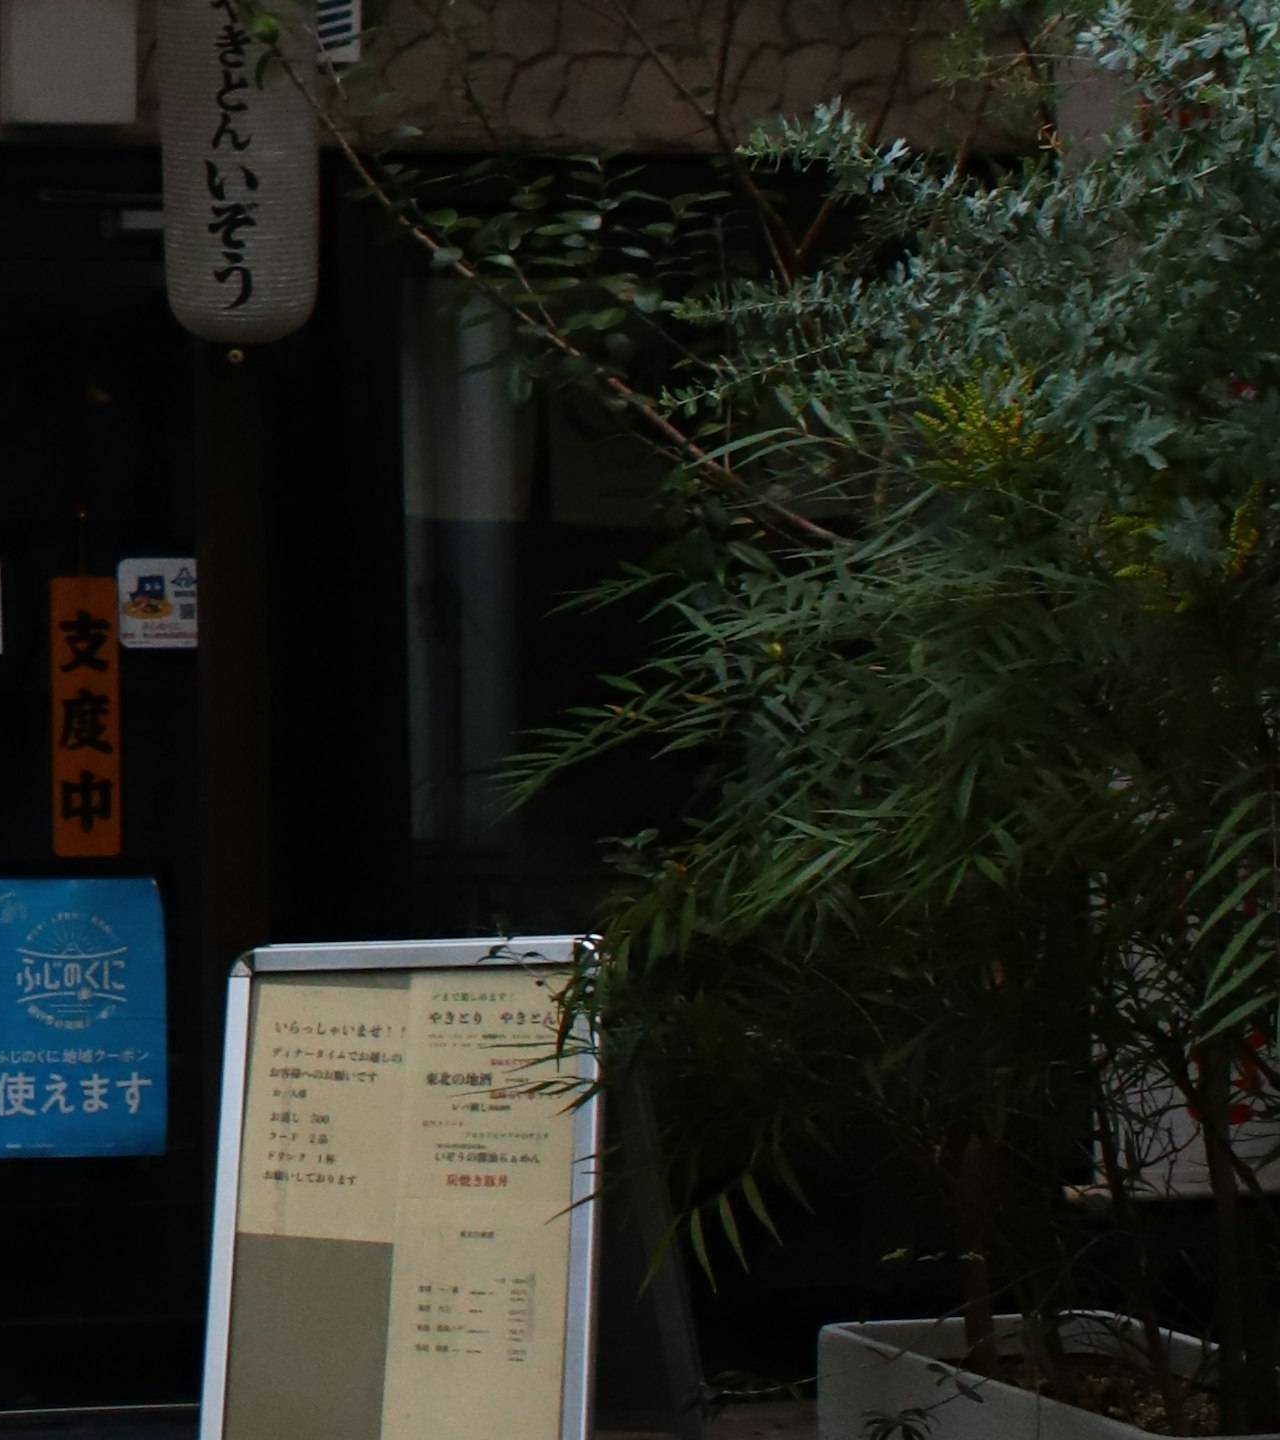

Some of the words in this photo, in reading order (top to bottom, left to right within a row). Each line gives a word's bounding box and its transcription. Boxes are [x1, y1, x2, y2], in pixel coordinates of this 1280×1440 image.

[204, 158, 260, 311] いぞう
[59, 609, 113, 834] 支度中
[16, 957, 126, 994] ふじのくに
[429, 1011, 483, 1025] やきとり
[500, 1011, 556, 1025] やきとん
